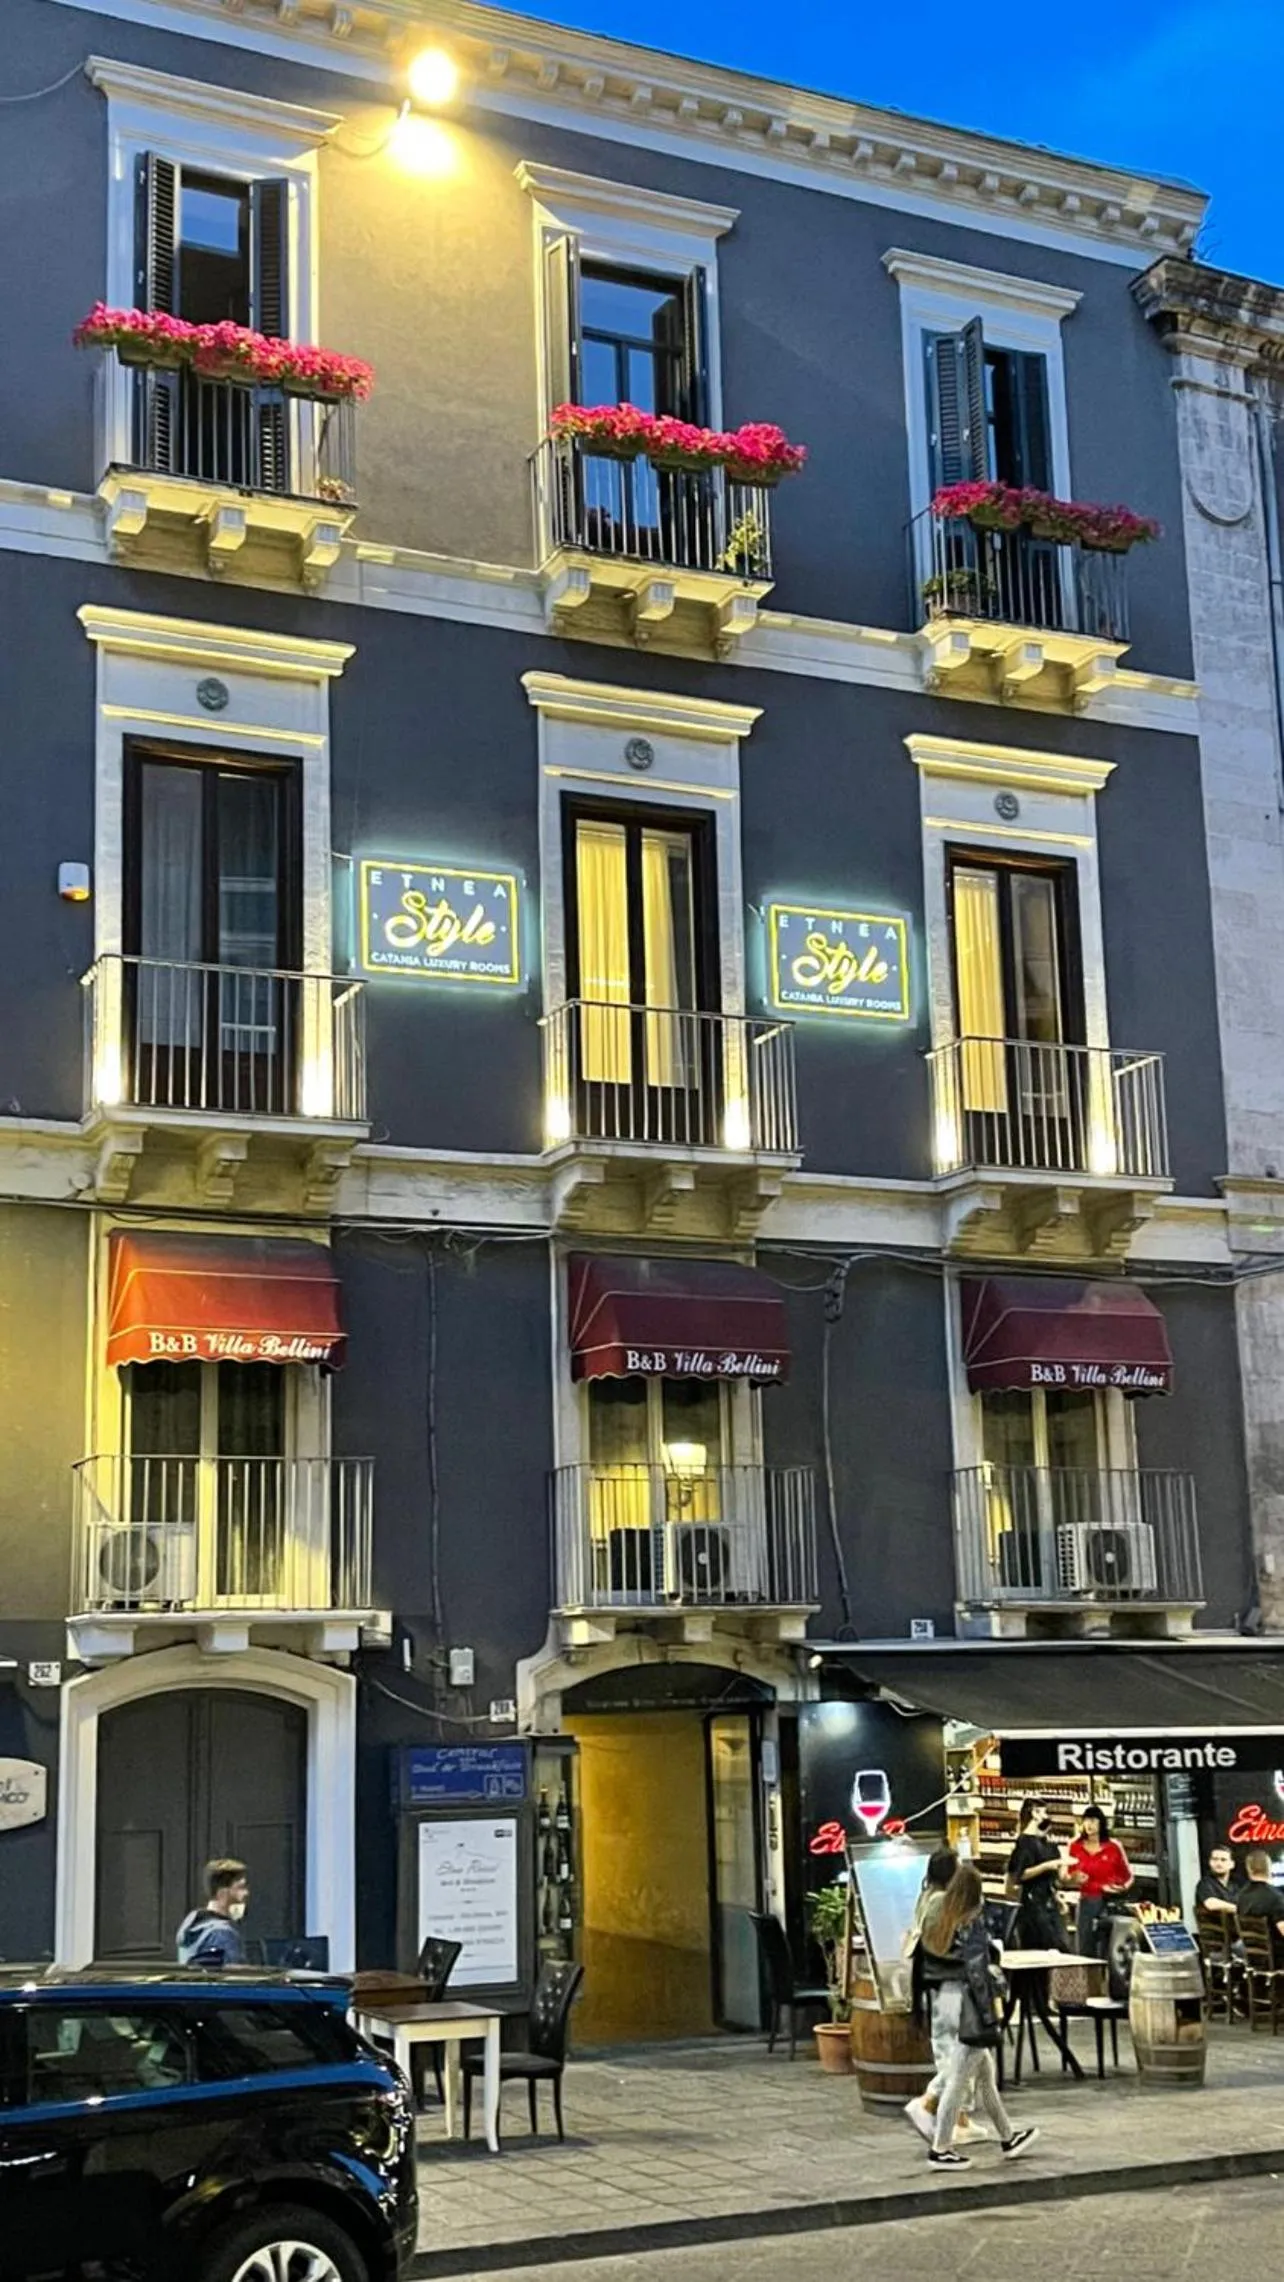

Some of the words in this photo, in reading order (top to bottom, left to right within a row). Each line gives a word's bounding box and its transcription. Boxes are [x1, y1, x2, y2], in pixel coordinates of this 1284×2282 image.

[370, 870, 508, 899] ETNEA
[384, 889, 496, 958] Style
[778, 914, 898, 941] ETNEA
[371, 951, 421, 967] CATANIA
[423, 956, 468, 972] LUXURY
[469, 960, 511, 975] ROOMS
[791, 931, 889, 995] Style
[780, 989, 825, 1004] CATANIA
[825, 994, 866, 1008] LUXURY
[866, 998, 902, 1012] ROOMS
[148, 1331, 198, 1354] B&B
[203, 1333, 255, 1356] Villa
[257, 1335, 332, 1360] Bellini
[626, 1350, 667, 1371] B&B
[674, 1351, 713, 1373] Villa
[716, 1352, 781, 1375] Bellini
[1030, 1364, 1066, 1382] B&B
[1072, 1364, 1106, 1384] Villa
[1109, 1365, 1166, 1387] Bellini
[1056, 1742, 1237, 1771] Ristorante
